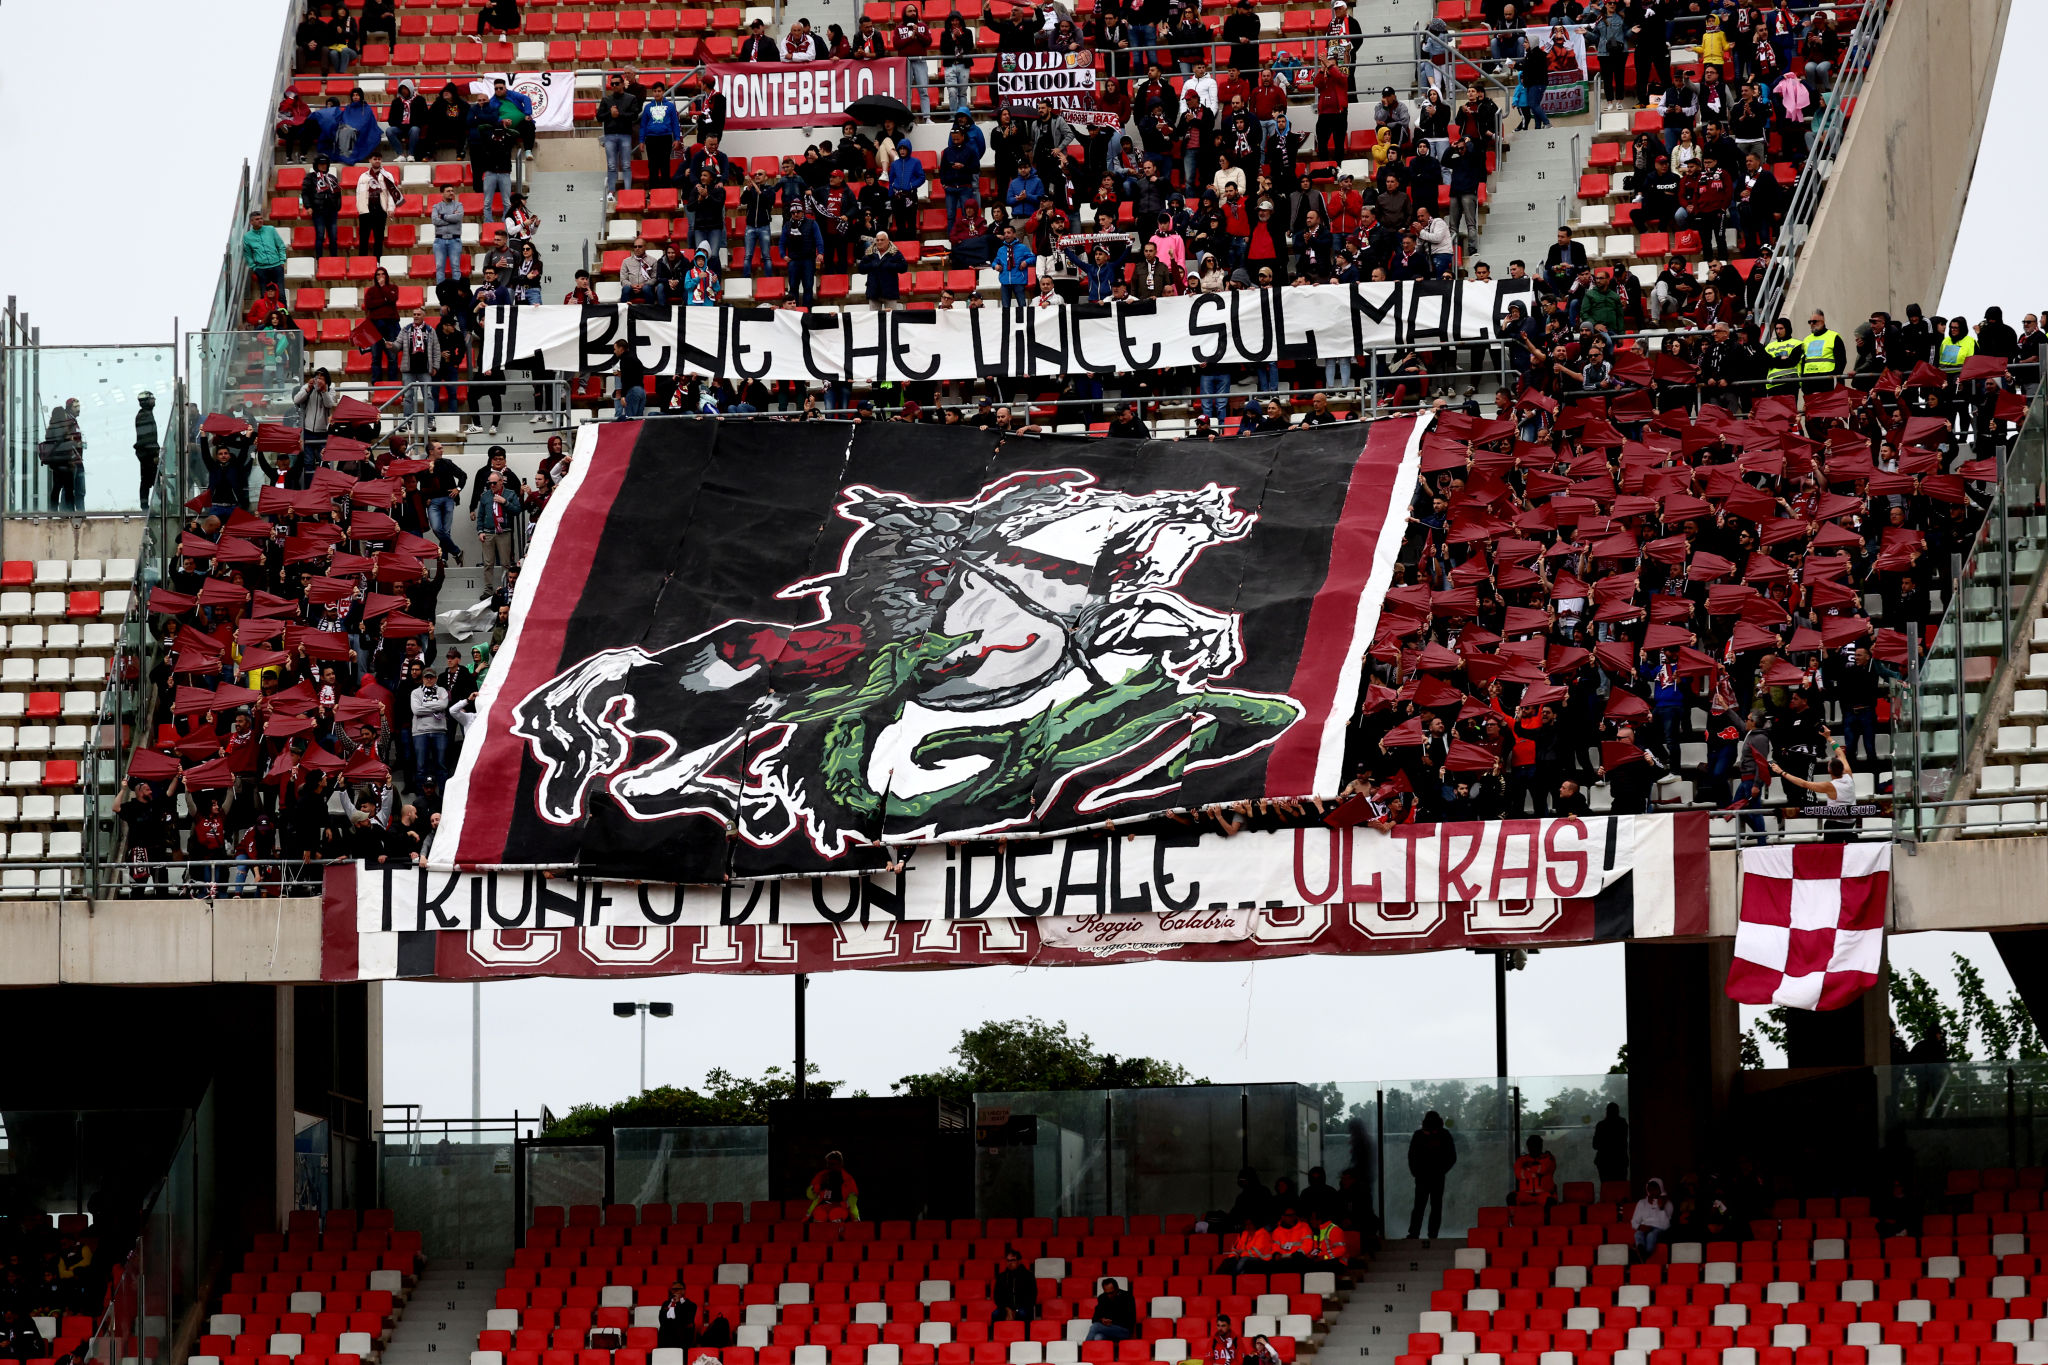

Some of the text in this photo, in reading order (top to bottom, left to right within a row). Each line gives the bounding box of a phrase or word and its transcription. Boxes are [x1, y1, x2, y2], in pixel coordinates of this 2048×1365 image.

[1018, 51, 1063, 71] OLD
[506, 72, 552, 87] V S
[998, 71, 1081, 92] SCHOOL
[713, 67, 874, 118] MONTEBELLO
[1547, 141, 1556, 149] 22
[1537, 171, 1546, 180] 21
[566, 184, 575, 192] 22
[1527, 202, 1536, 211] 20
[558, 214, 567, 223] 21
[1517, 234, 1526, 243] 19
[551, 243, 560, 252] 20
[543, 275, 552, 284] 19
[578, 304, 774, 379] BENE
[801, 309, 942, 381] CHE
[1189, 286, 1318, 364] SUL
[1350, 278, 1534, 357] MALE
[521, 370, 530, 379] 16
[513, 402, 522, 411] 15
[466, 580, 475, 589] 11
[811, 872, 906, 922] UN
[1067, 914, 1144, 942] Reggio
[1157, 909, 1236, 932] Calabria
[1410, 1261, 1419, 1271] 22
[457, 1280, 466, 1290] 22
[1396, 1283, 1406, 1292] 21
[447, 1300, 456, 1311] 21
[1384, 1303, 1394, 1313] 20
[437, 1321, 447, 1331] 20
[1372, 1325, 1382, 1335] 19
[1360, 1347, 1370, 1357] 18
